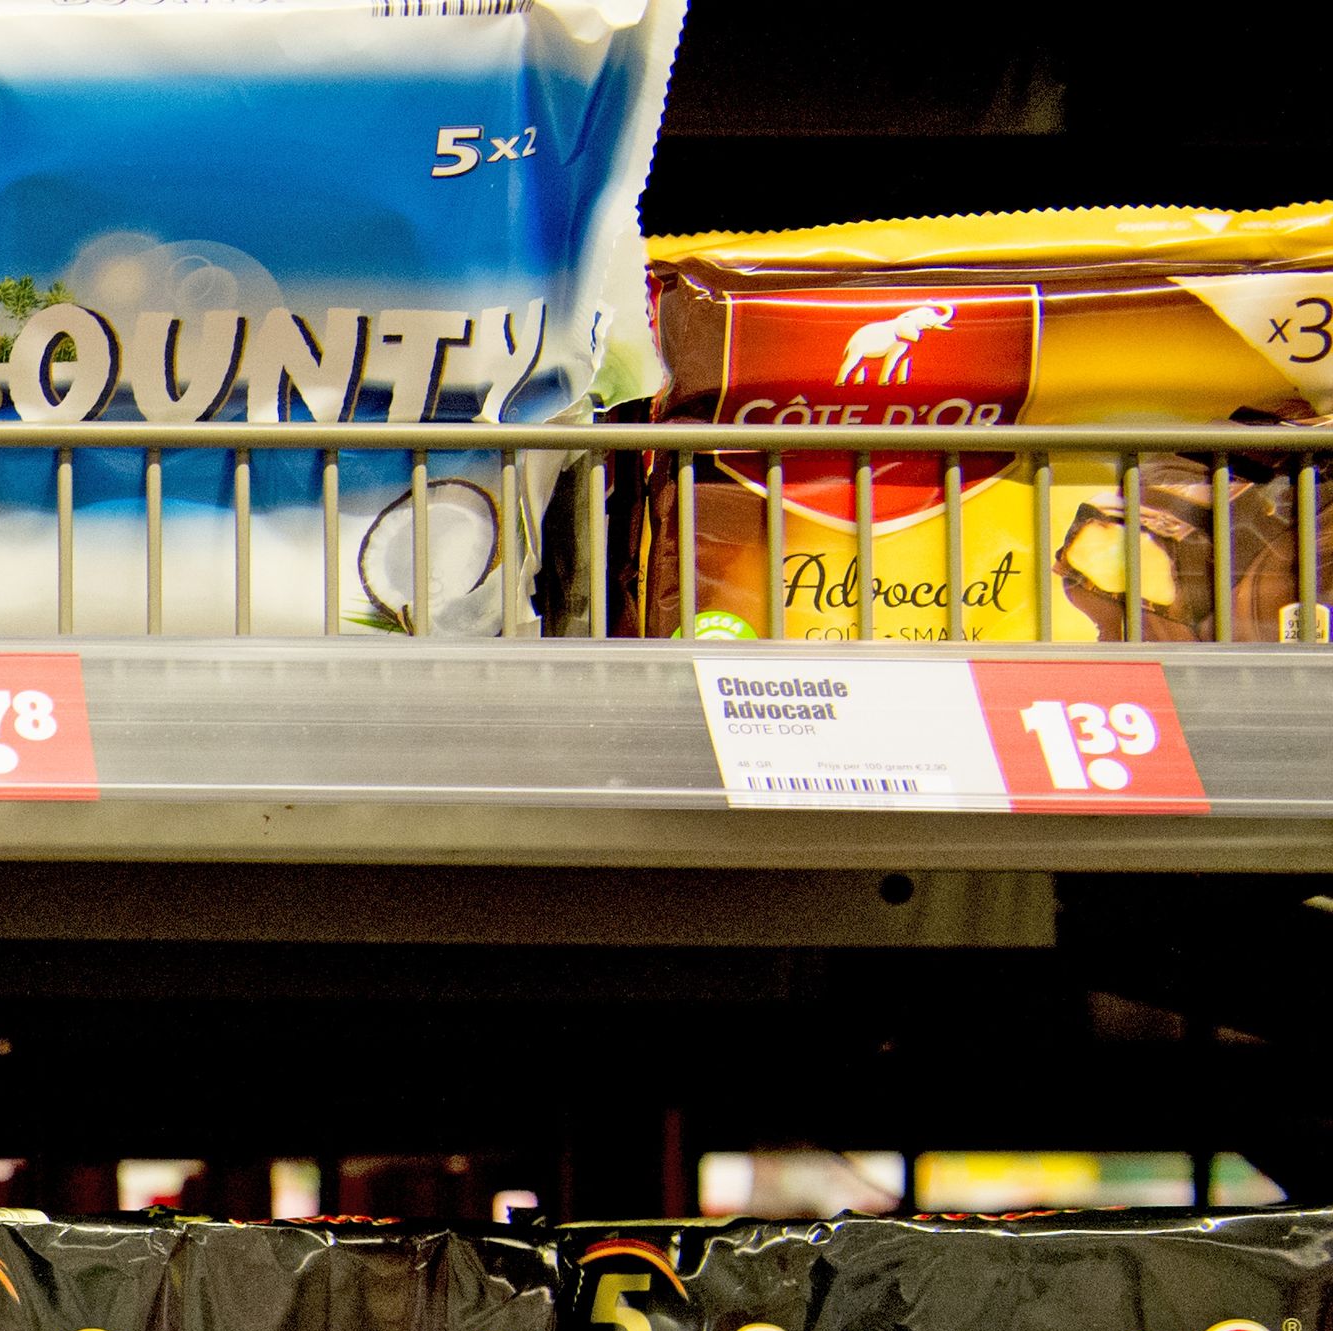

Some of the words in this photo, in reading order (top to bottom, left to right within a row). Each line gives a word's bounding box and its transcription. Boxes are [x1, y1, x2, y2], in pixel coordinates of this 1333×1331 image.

[1267, 298, 1333, 363] x3
[716, 677, 850, 698] Chocolade
[723, 700, 838, 721] Advocaat
[728, 723, 774, 736] COTE
[778, 724, 817, 737] DOR
[1021, 700, 1160, 790] 1.39
[817, 761, 842, 771] Prijs
[844, 763, 861, 772] per
[864, 761, 883, 770] 100
[885, 763, 914, 772] gram
